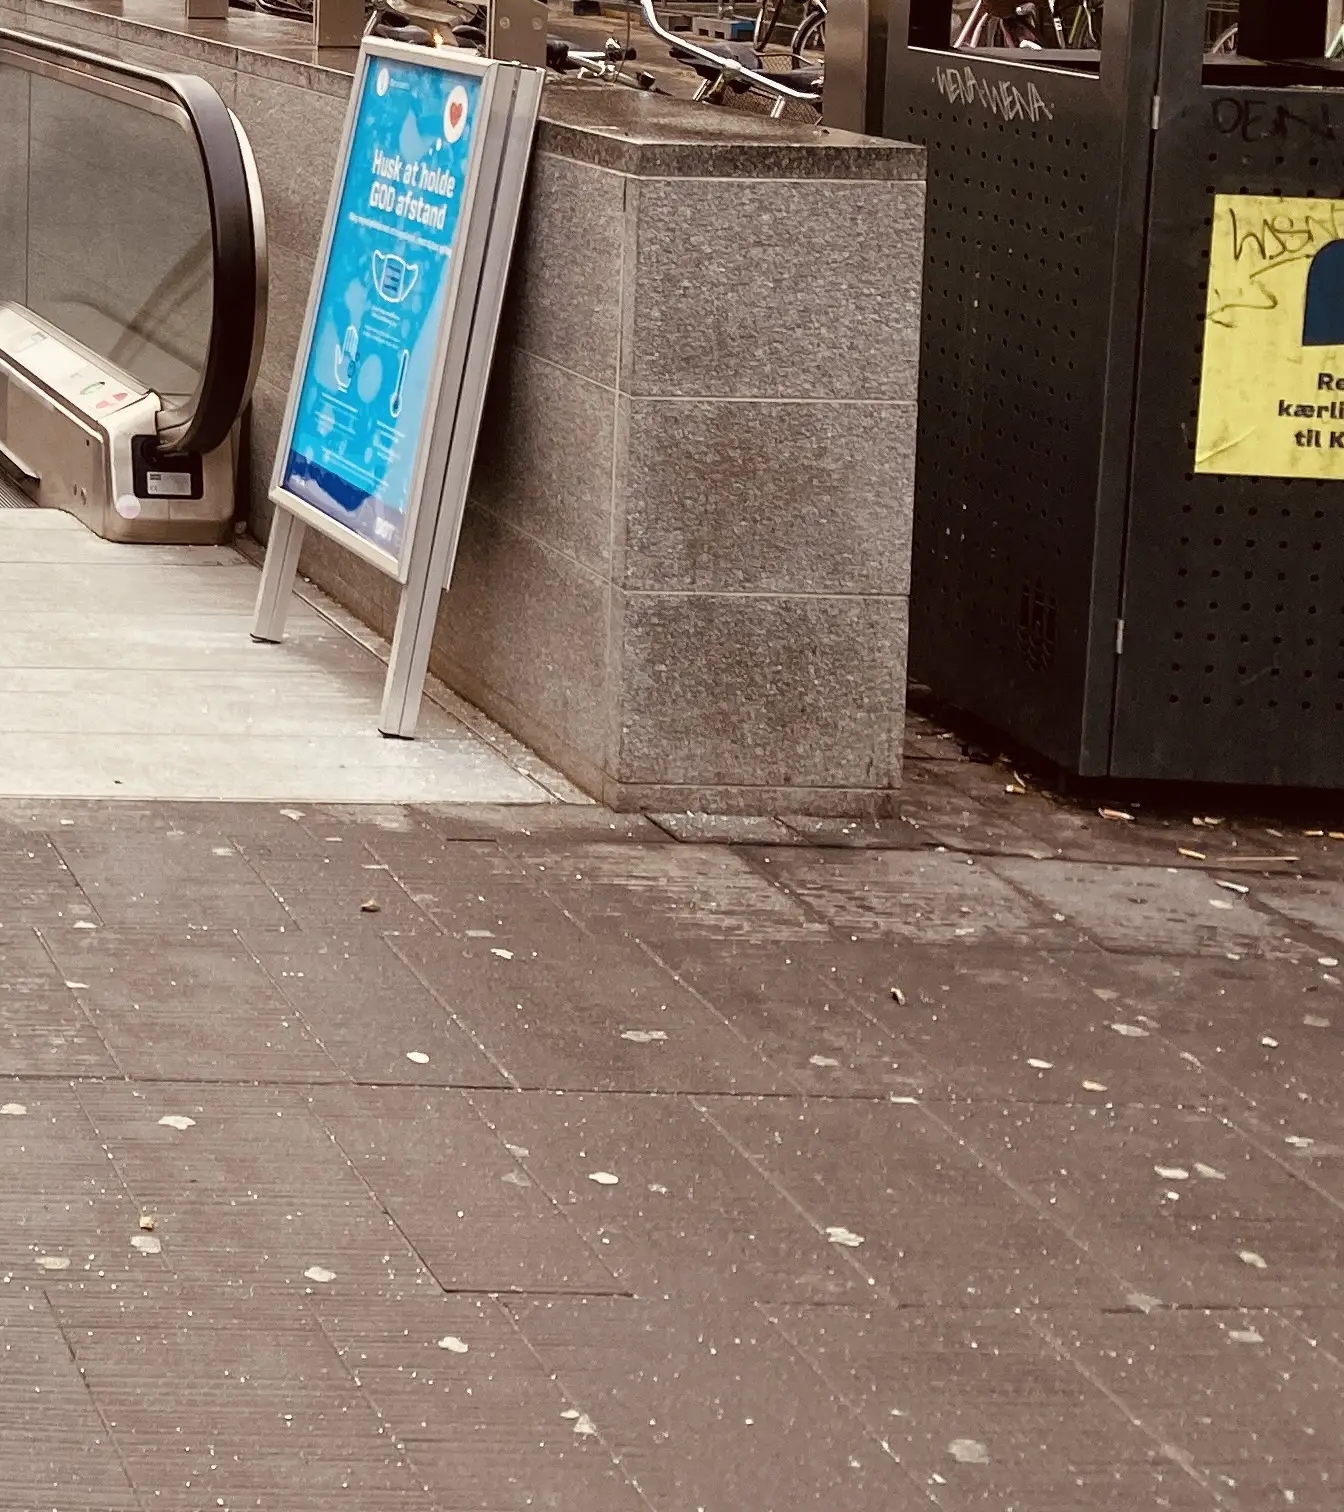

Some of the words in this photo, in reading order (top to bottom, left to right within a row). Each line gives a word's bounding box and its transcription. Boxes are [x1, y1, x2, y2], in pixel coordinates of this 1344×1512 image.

[372, 149, 400, 182] Husk
[403, 162, 419, 187] at
[419, 163, 456, 198] holde
[369, 181, 396, 213] GOD
[395, 191, 447, 231] afstand
[1295, 429, 1321, 448] til
